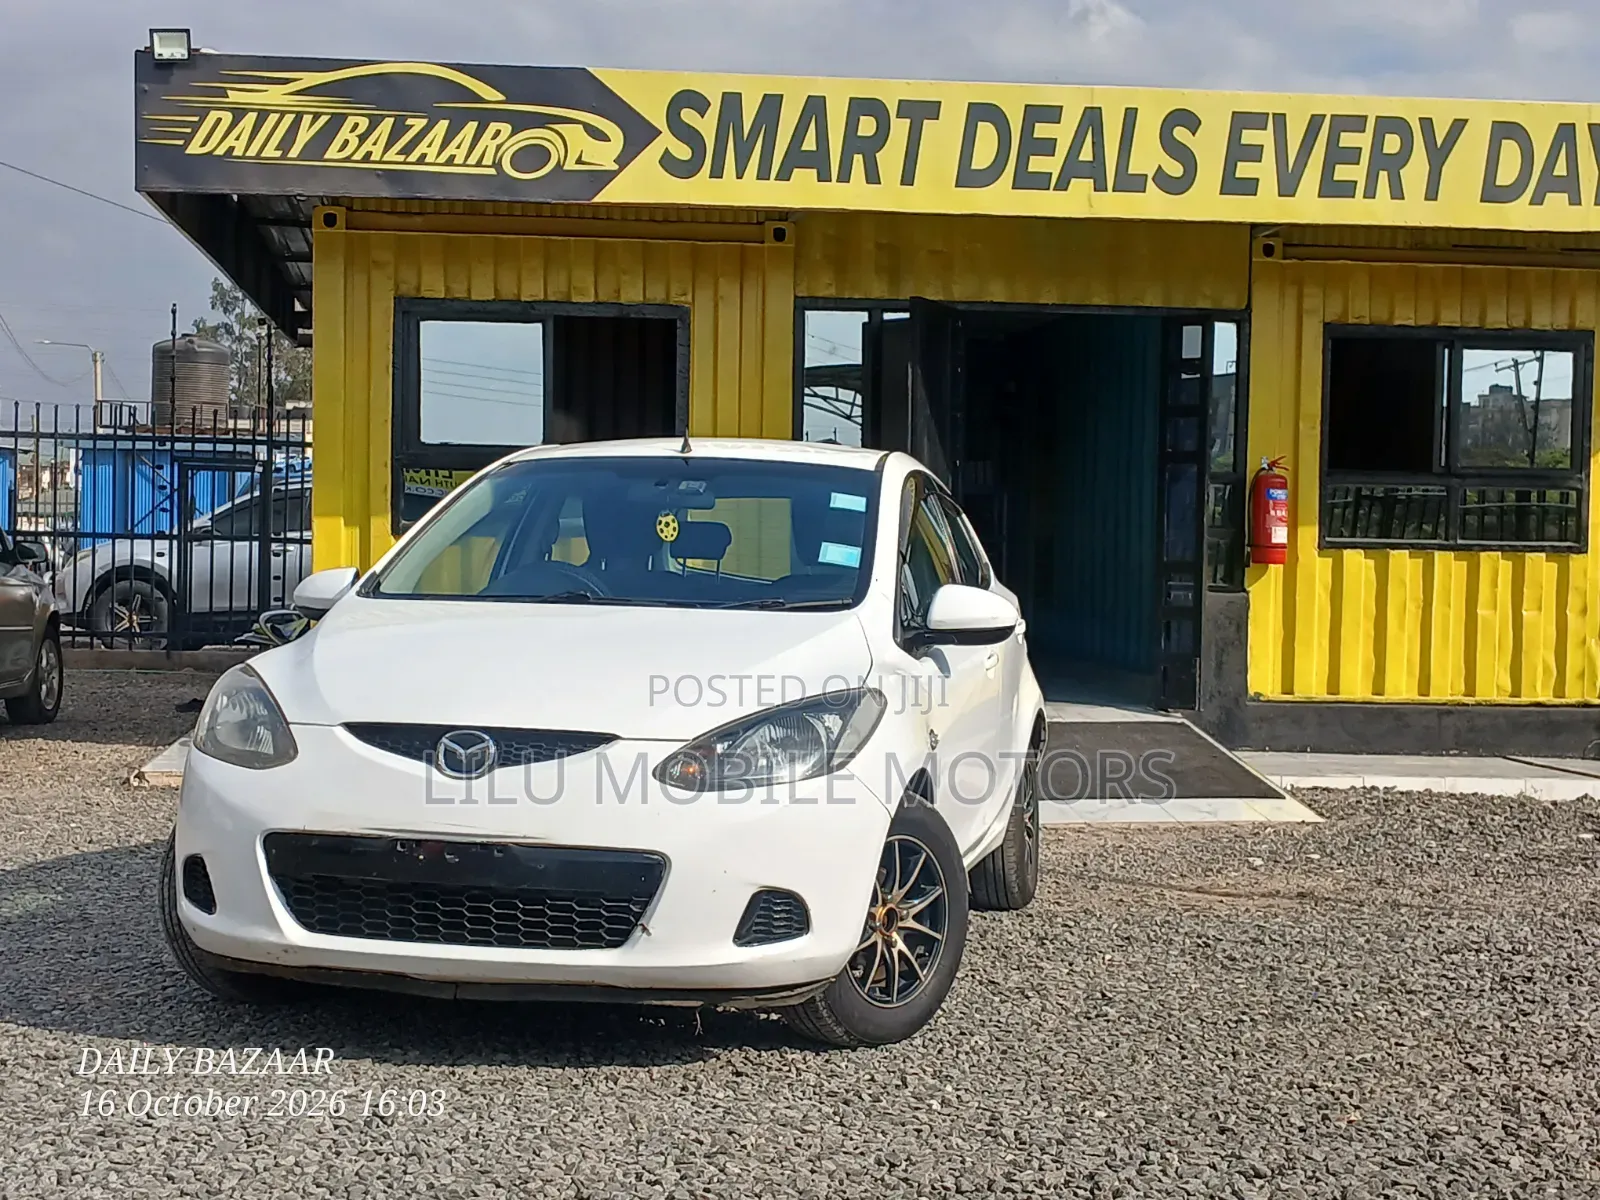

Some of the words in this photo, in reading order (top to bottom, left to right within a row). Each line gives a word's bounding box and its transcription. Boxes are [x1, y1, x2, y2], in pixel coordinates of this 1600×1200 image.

[185, 109, 331, 158] DAILY
[323, 115, 512, 165] BAZAAR
[658, 88, 942, 187] SMART
[955, 101, 1202, 196] DEALS
[1219, 110, 1470, 202] EVERY
[1479, 120, 1600, 207] DA
